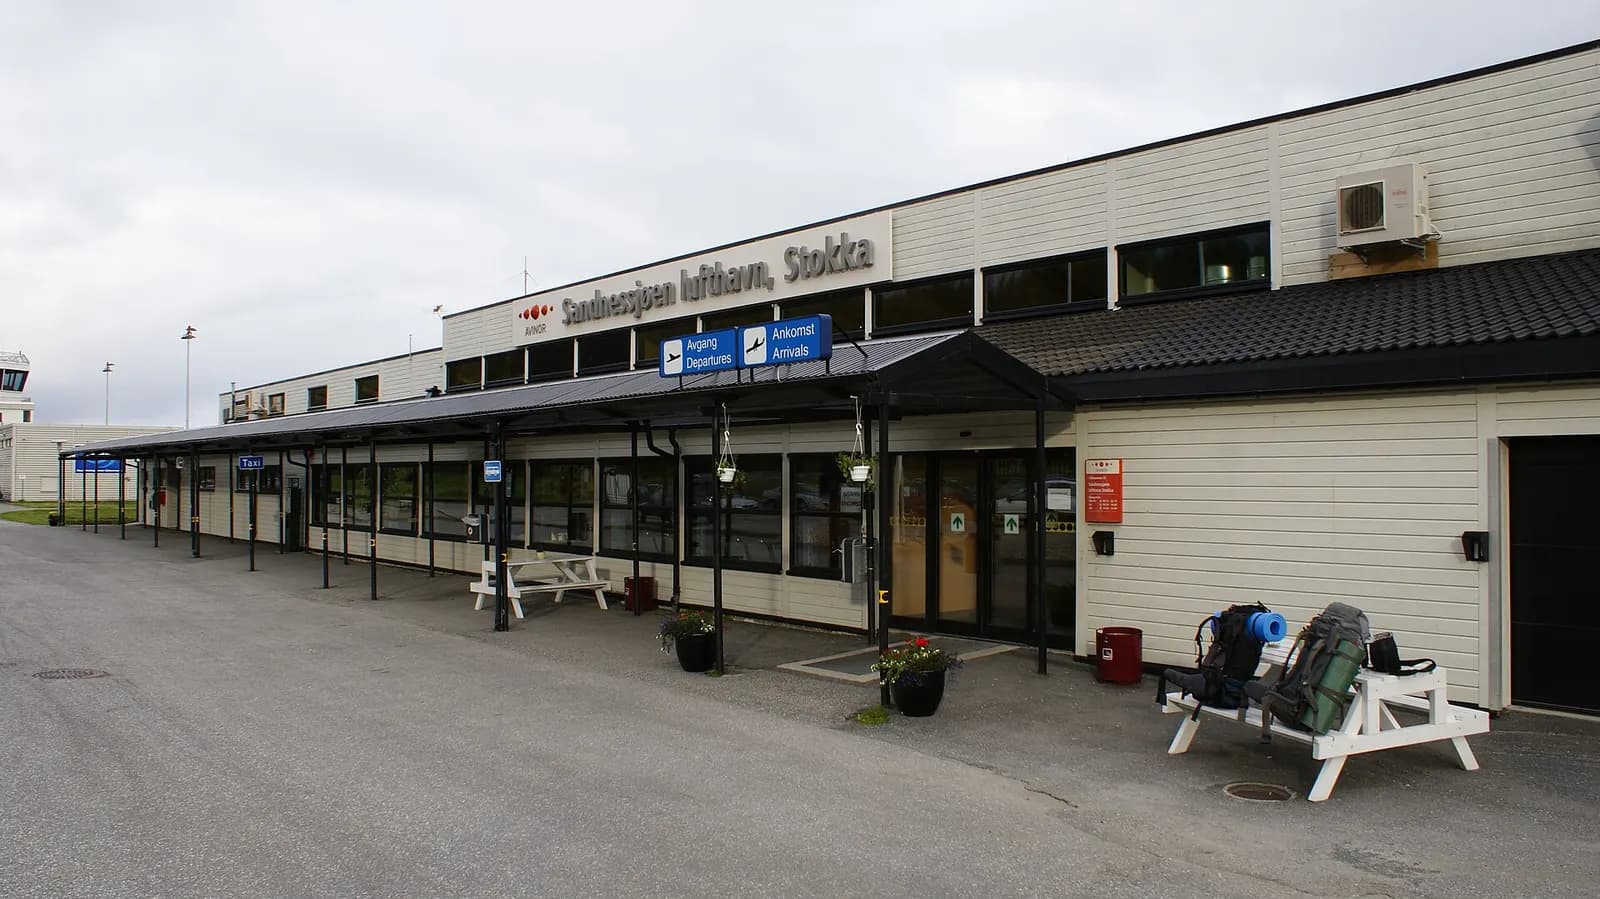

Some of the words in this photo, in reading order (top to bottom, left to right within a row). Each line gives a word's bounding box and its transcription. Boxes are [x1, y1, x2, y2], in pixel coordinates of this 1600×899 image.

[562, 280, 676, 325] Sandnessjøen
[680, 261, 775, 303] lufthavn,
[784, 232, 874, 283] Stokka
[772, 323, 815, 340] Ankomst
[686, 337, 717, 353] Avgang
[772, 343, 809, 360] Arrivals
[686, 353, 732, 370] Departures
[241, 458, 261, 467] Taxi
